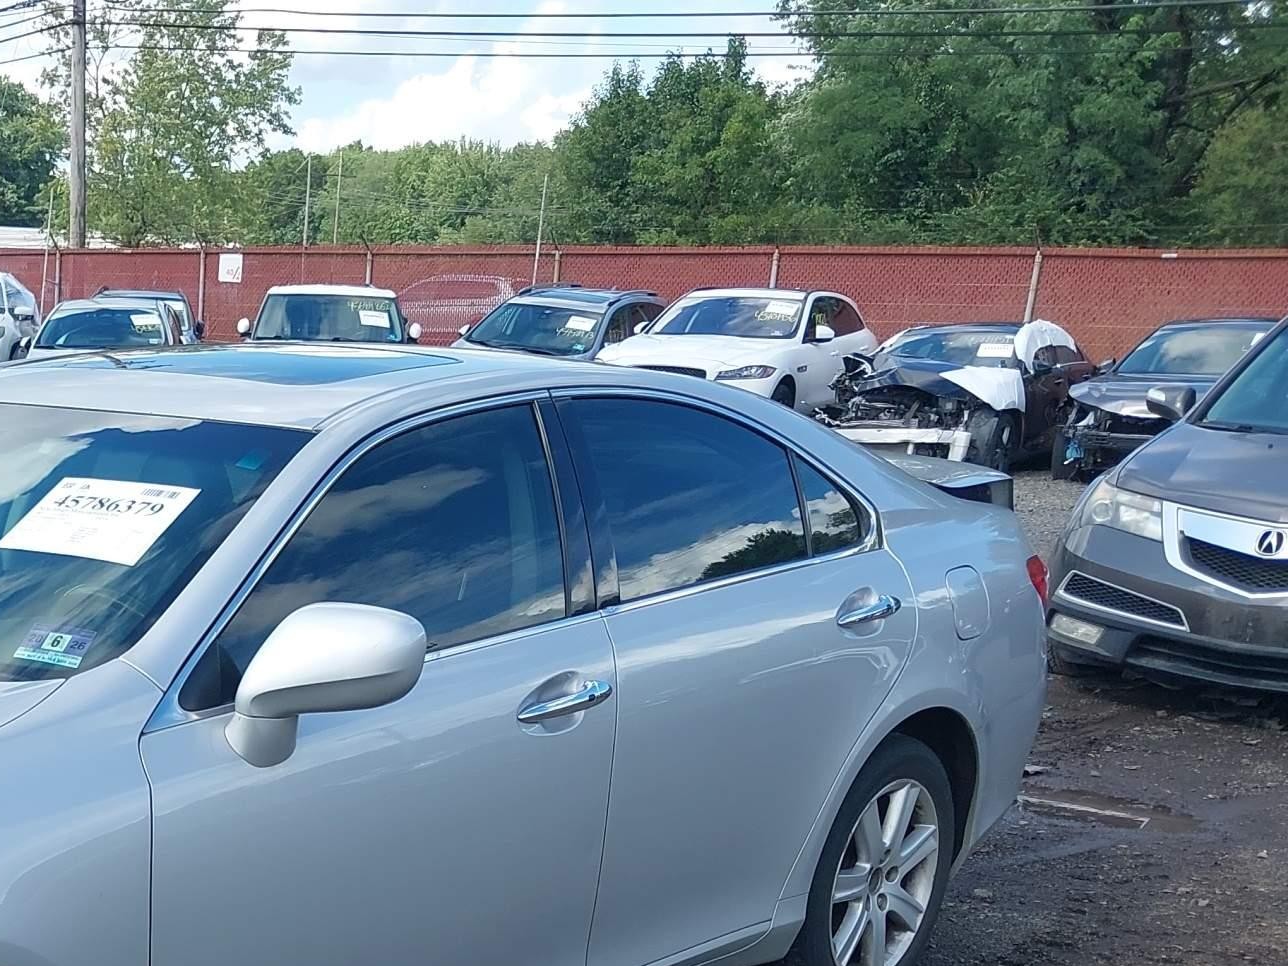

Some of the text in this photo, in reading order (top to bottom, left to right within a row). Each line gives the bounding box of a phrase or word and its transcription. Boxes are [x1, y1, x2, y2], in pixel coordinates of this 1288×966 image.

[53, 495, 165, 517] 45786379
[51, 635, 64, 648] 6
[69, 640, 87, 650] 26
